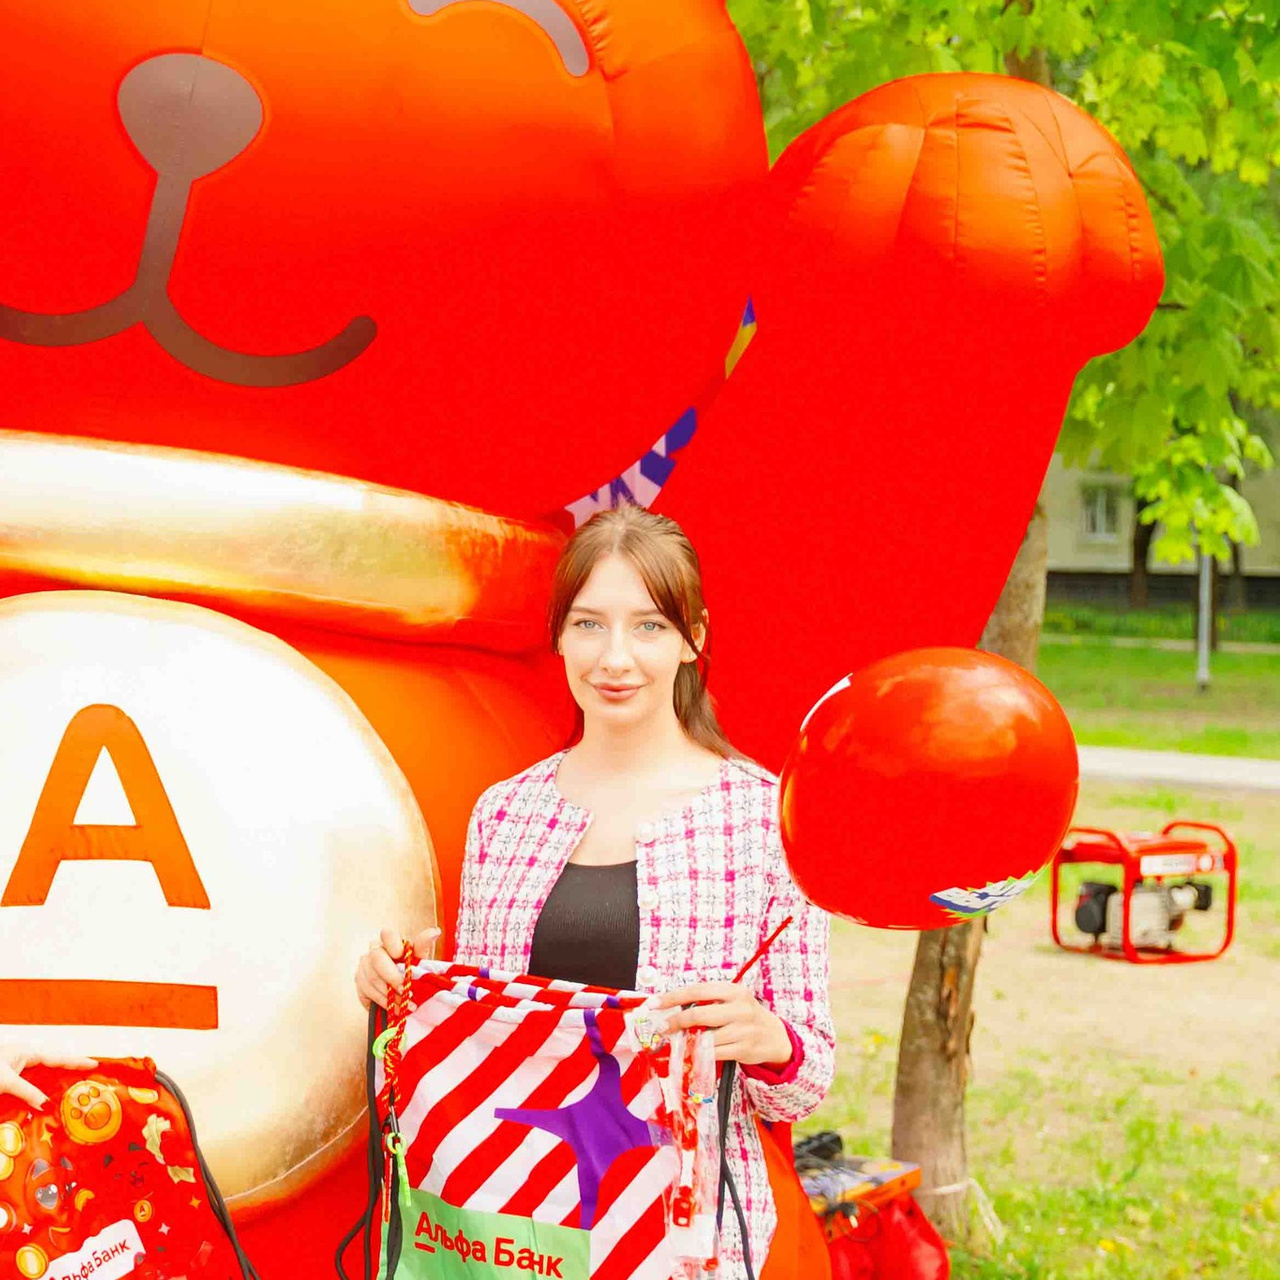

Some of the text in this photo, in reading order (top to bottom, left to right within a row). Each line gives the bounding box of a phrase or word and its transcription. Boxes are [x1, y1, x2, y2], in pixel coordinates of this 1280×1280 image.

[91, 1239, 131, 1268] Банк
[414, 1211, 564, 1279] Альфа Банк
